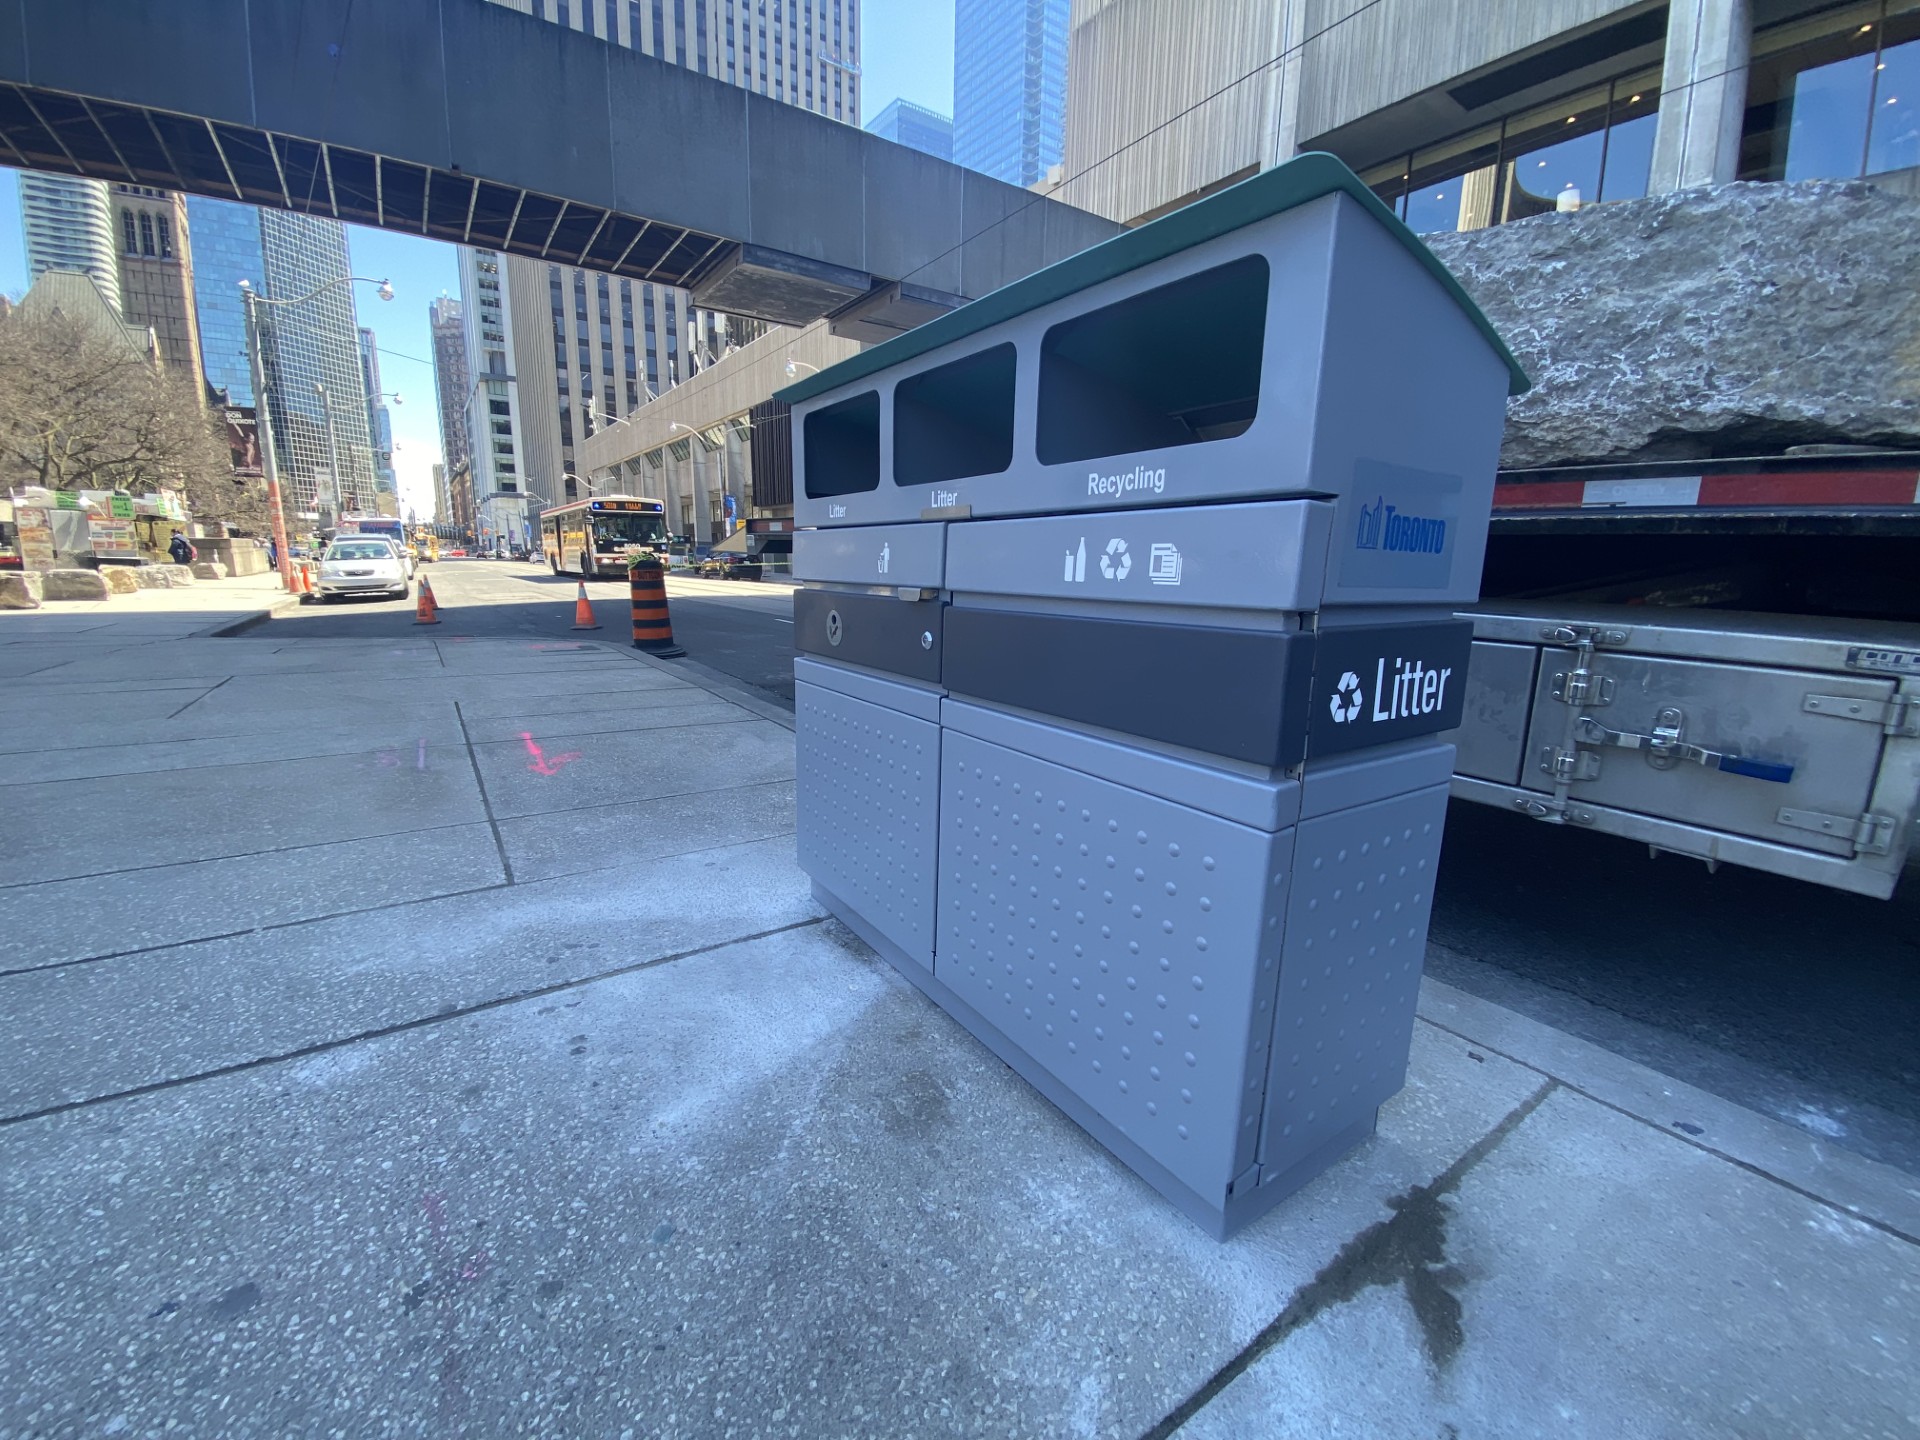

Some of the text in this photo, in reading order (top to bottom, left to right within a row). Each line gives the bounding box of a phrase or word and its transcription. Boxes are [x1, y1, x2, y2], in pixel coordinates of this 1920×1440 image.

[1087, 465, 1166, 498] Recycling
[828, 504, 847, 518] Litter
[931, 490, 958, 508] Litter
[1372, 657, 1452, 722] Litter
